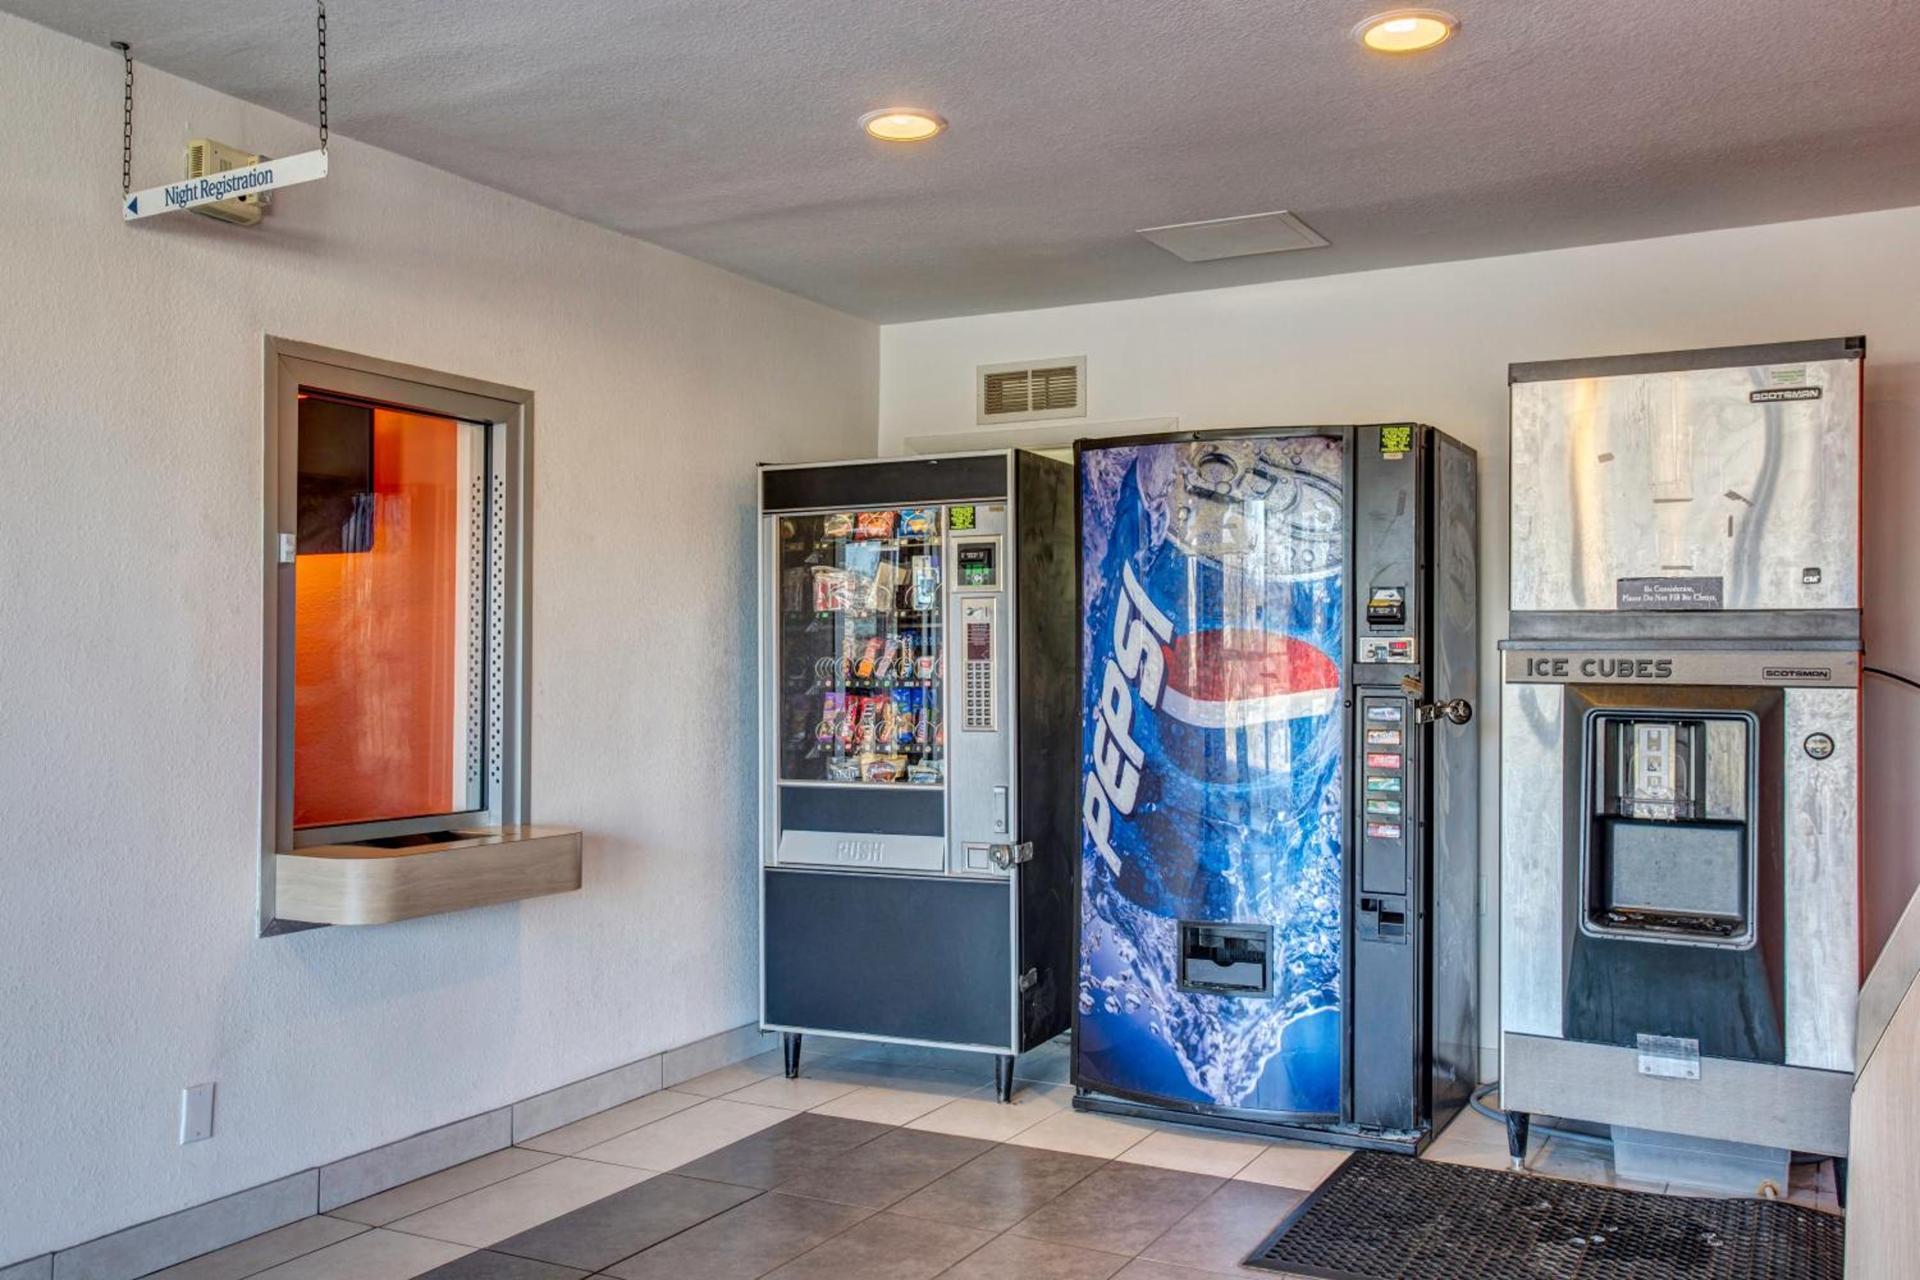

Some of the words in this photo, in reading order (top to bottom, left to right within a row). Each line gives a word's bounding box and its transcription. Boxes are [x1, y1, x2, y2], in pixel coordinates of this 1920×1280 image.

[164, 184, 198, 208] Night
[200, 168, 274, 200] Registration
[1752, 389, 1819, 400] SCOTSMAN
[1526, 657, 1569, 676] ICE
[1580, 658, 1673, 678] CUBES
[1766, 669, 1828, 678] SCOTSMAN
[1083, 559, 1175, 877] PEPSI
[836, 841, 884, 862] PUSH
